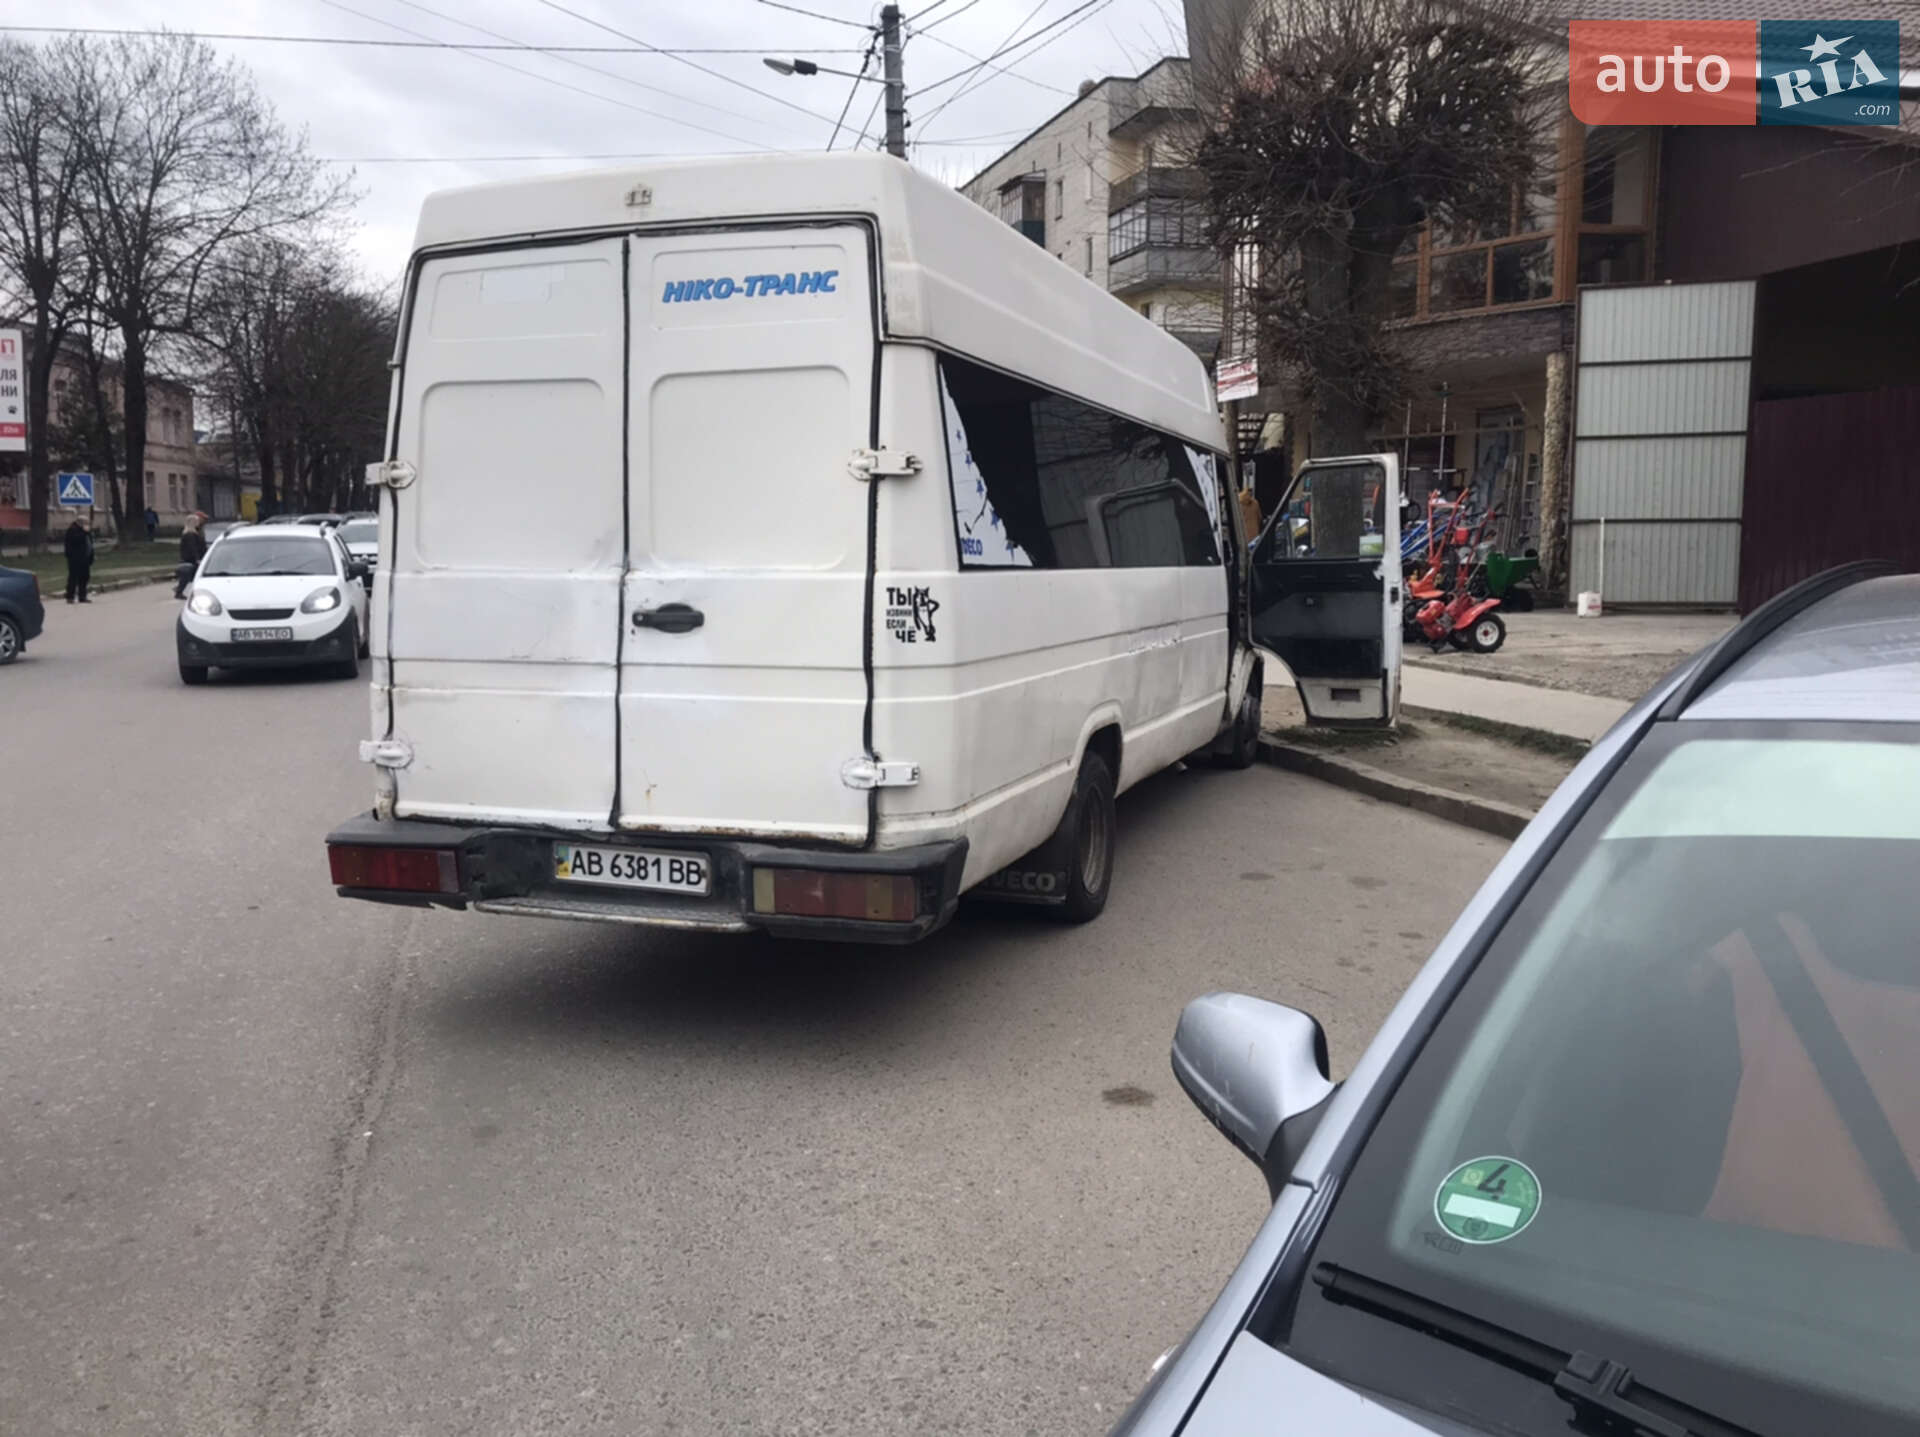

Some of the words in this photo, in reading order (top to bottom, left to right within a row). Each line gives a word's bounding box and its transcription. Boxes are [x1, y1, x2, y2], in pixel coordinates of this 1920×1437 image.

[662, 270, 839, 303] НІКО-ТРАНС
[0, 369, 17, 381] ЛЯ
[886, 587, 912, 606] ТЫ
[571, 850, 604, 876] AB
[610, 853, 662, 883] 6381
[669, 859, 703, 886] BB
[1477, 1163, 1511, 1201] 4
